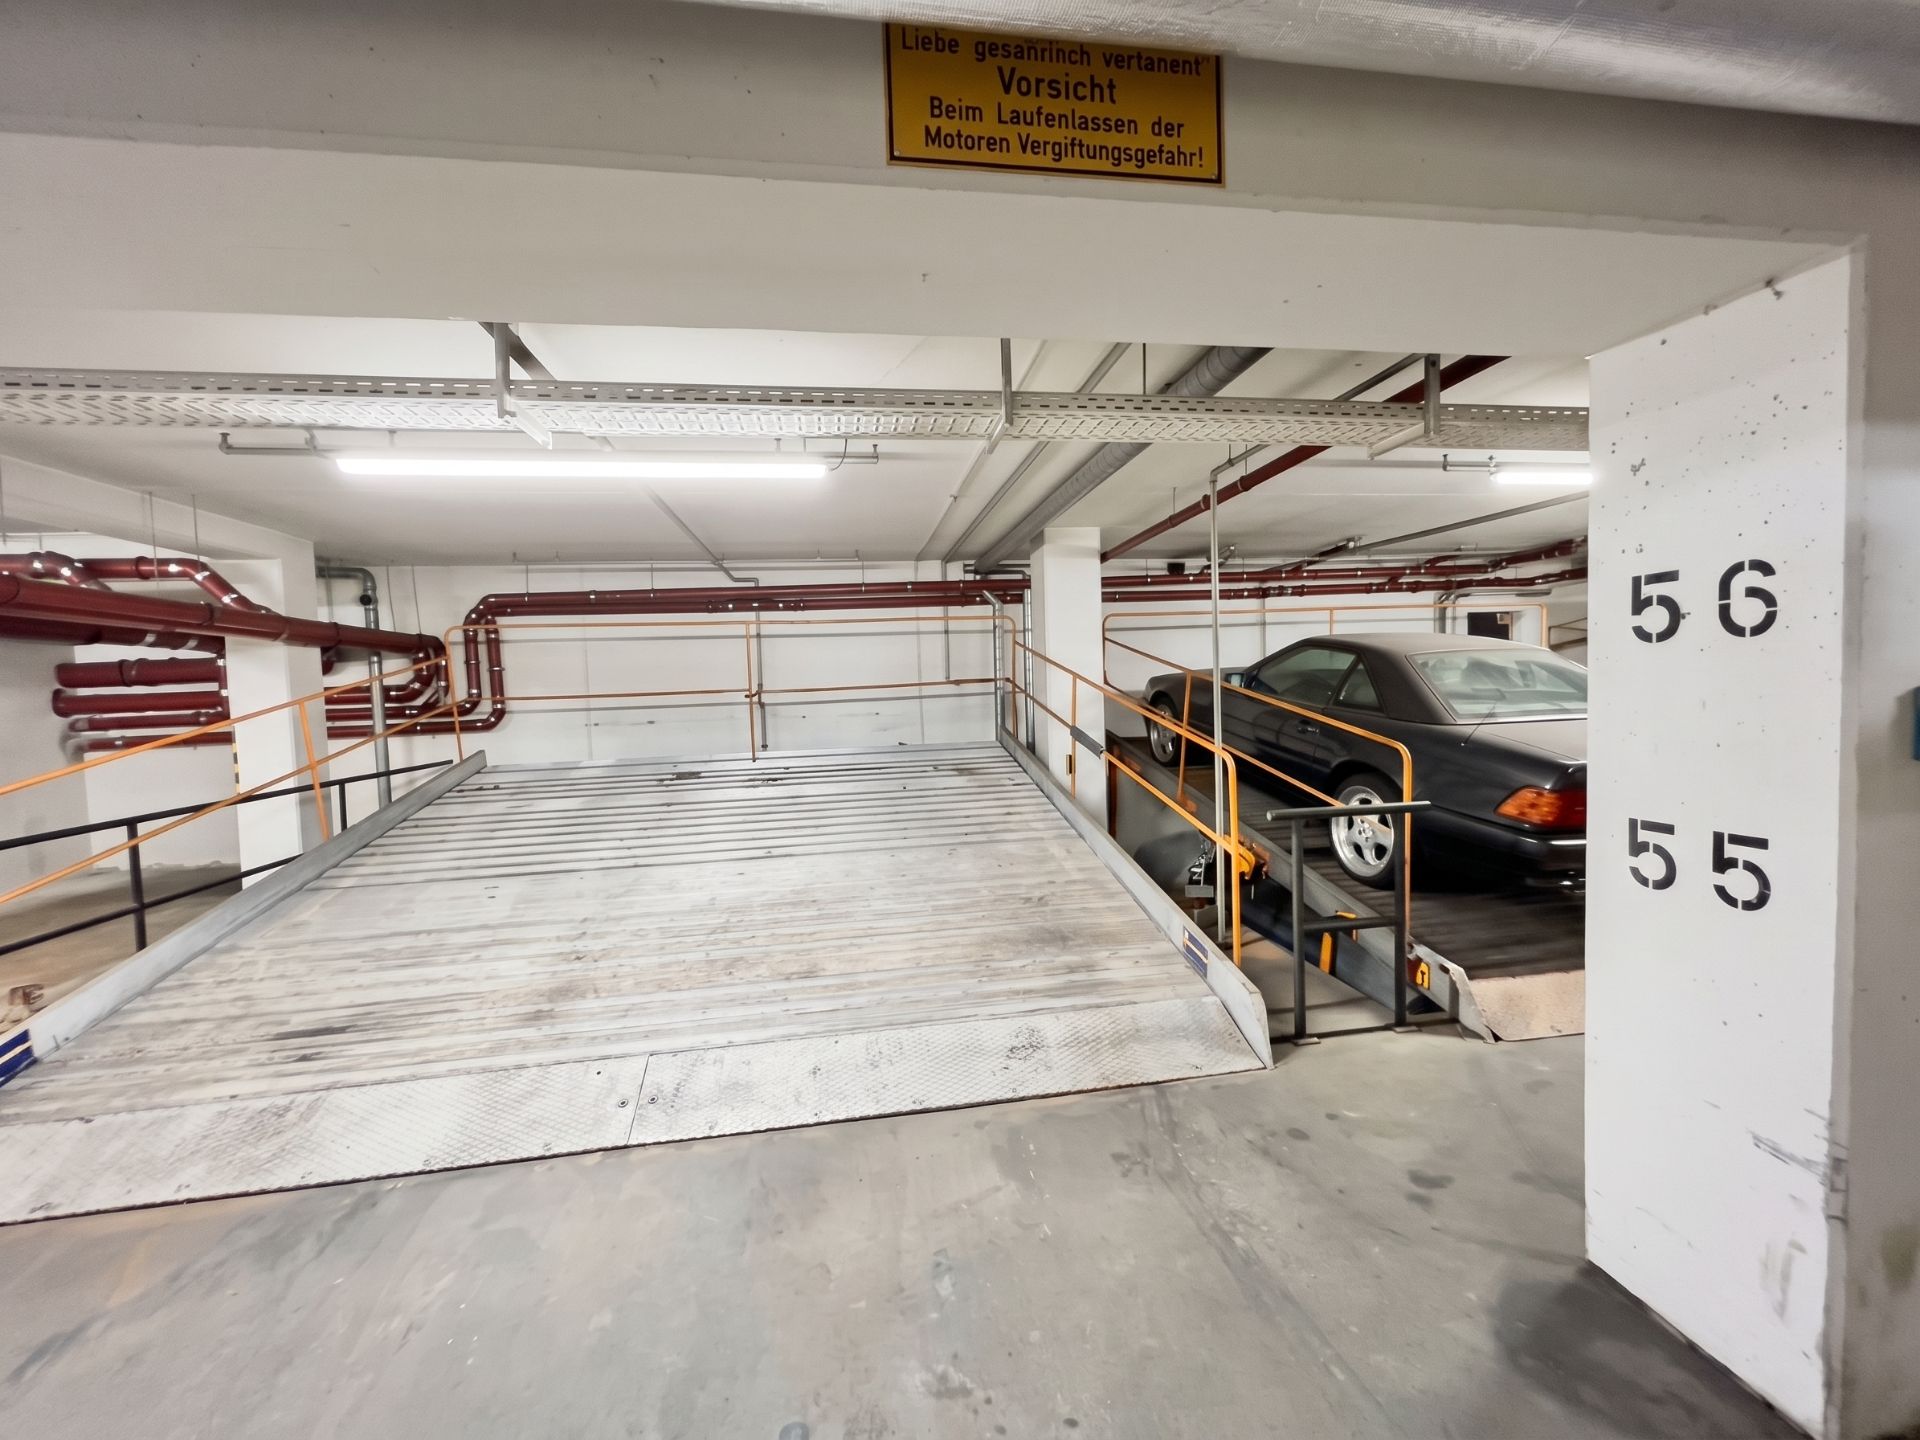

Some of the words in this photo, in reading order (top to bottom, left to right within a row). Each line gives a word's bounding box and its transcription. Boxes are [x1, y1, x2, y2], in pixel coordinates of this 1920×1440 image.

[997, 65, 1117, 104] Vorsicht
[929, 96, 983, 122] Beim
[997, 102, 1138, 135] Laufenlassen
[1151, 116, 1184, 138] der
[924, 125, 1010, 152] Motoren
[1017, 132, 1204, 169] Vergiftungsgefahr!
